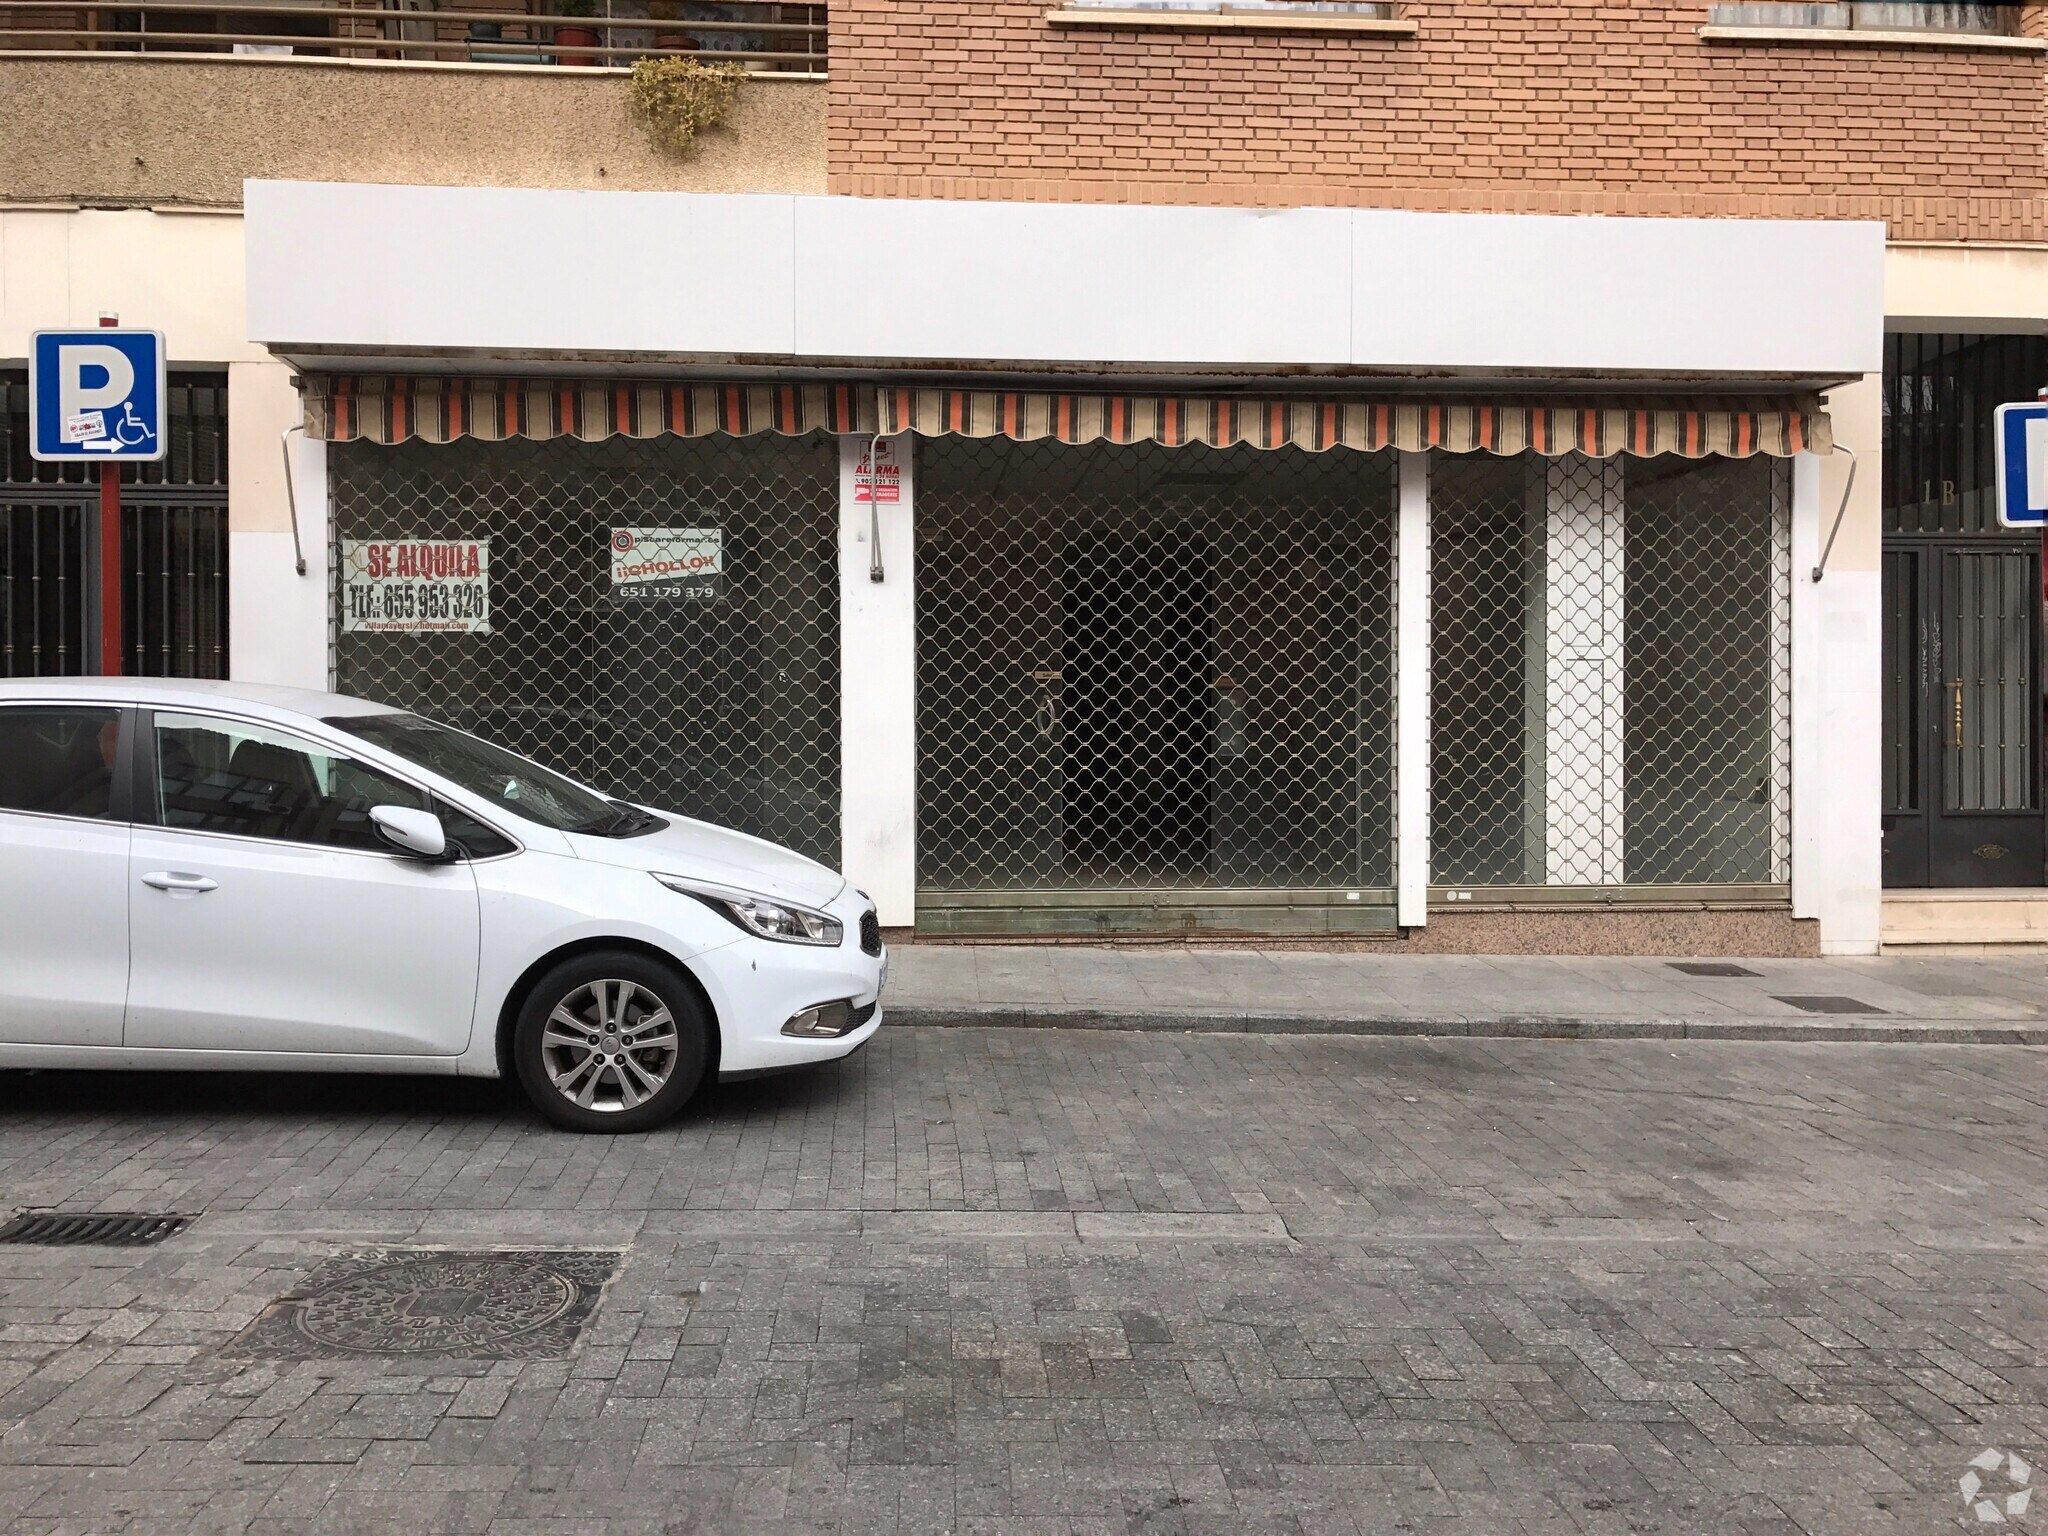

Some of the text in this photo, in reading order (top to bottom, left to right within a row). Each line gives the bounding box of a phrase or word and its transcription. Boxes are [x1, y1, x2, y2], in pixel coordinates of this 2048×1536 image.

[59, 345, 135, 443] P
[1942, 480, 1955, 506] B
[367, 544, 480, 580] SE ALQUILA
[384, 584, 414, 619] 655
[418, 584, 449, 619] 953
[620, 587, 714, 599] 651 179 379
